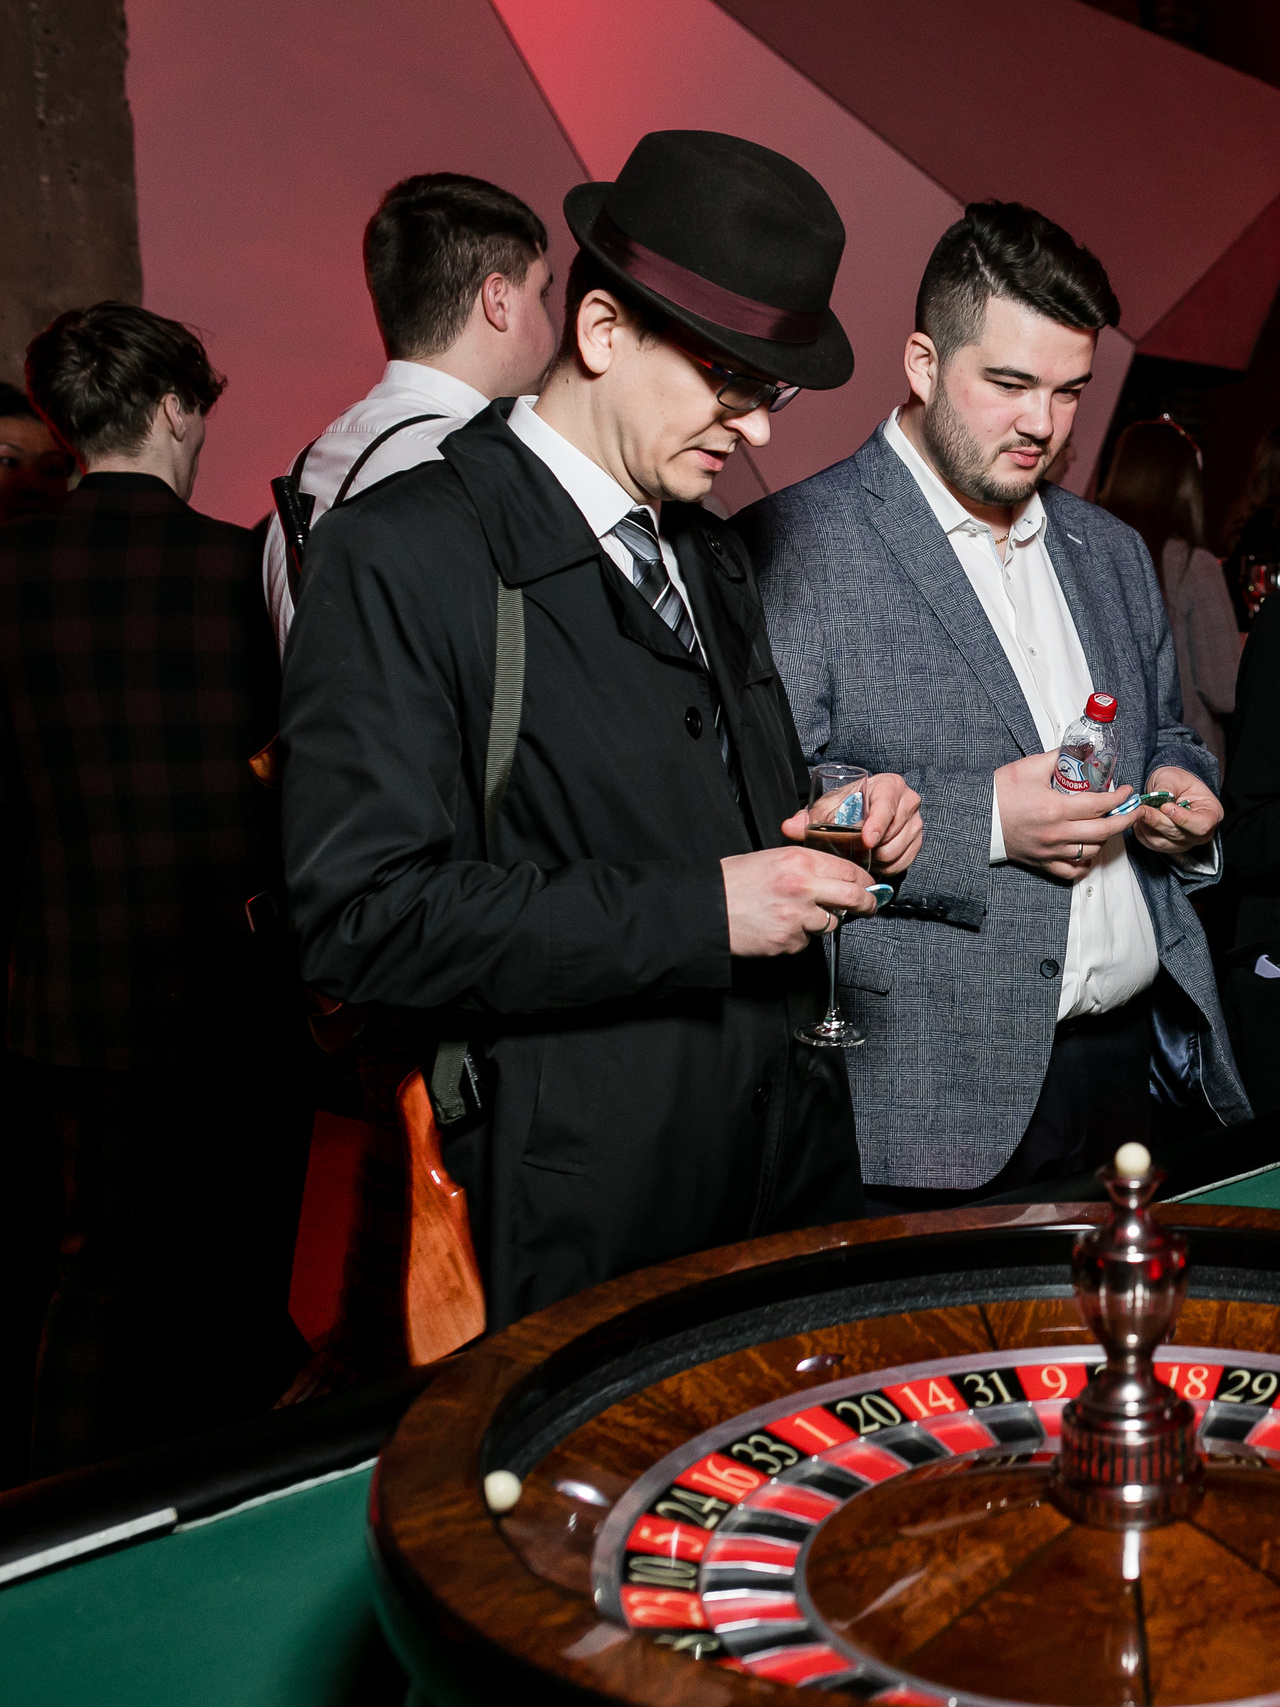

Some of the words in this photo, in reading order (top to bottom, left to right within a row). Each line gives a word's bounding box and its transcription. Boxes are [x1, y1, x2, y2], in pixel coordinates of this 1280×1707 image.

[899, 1379, 957, 1419] 14
[963, 1370, 1017, 1408] 31
[1040, 1364, 1068, 1400] 9
[1218, 1369, 1279, 1406] 29
[794, 1416, 841, 1448] 1
[835, 1393, 902, 1435] 20
[731, 1433, 799, 1476] 33
[691, 1458, 760, 1500] 16
[655, 1487, 730, 1531] 24
[628, 1555, 698, 1591] 10
